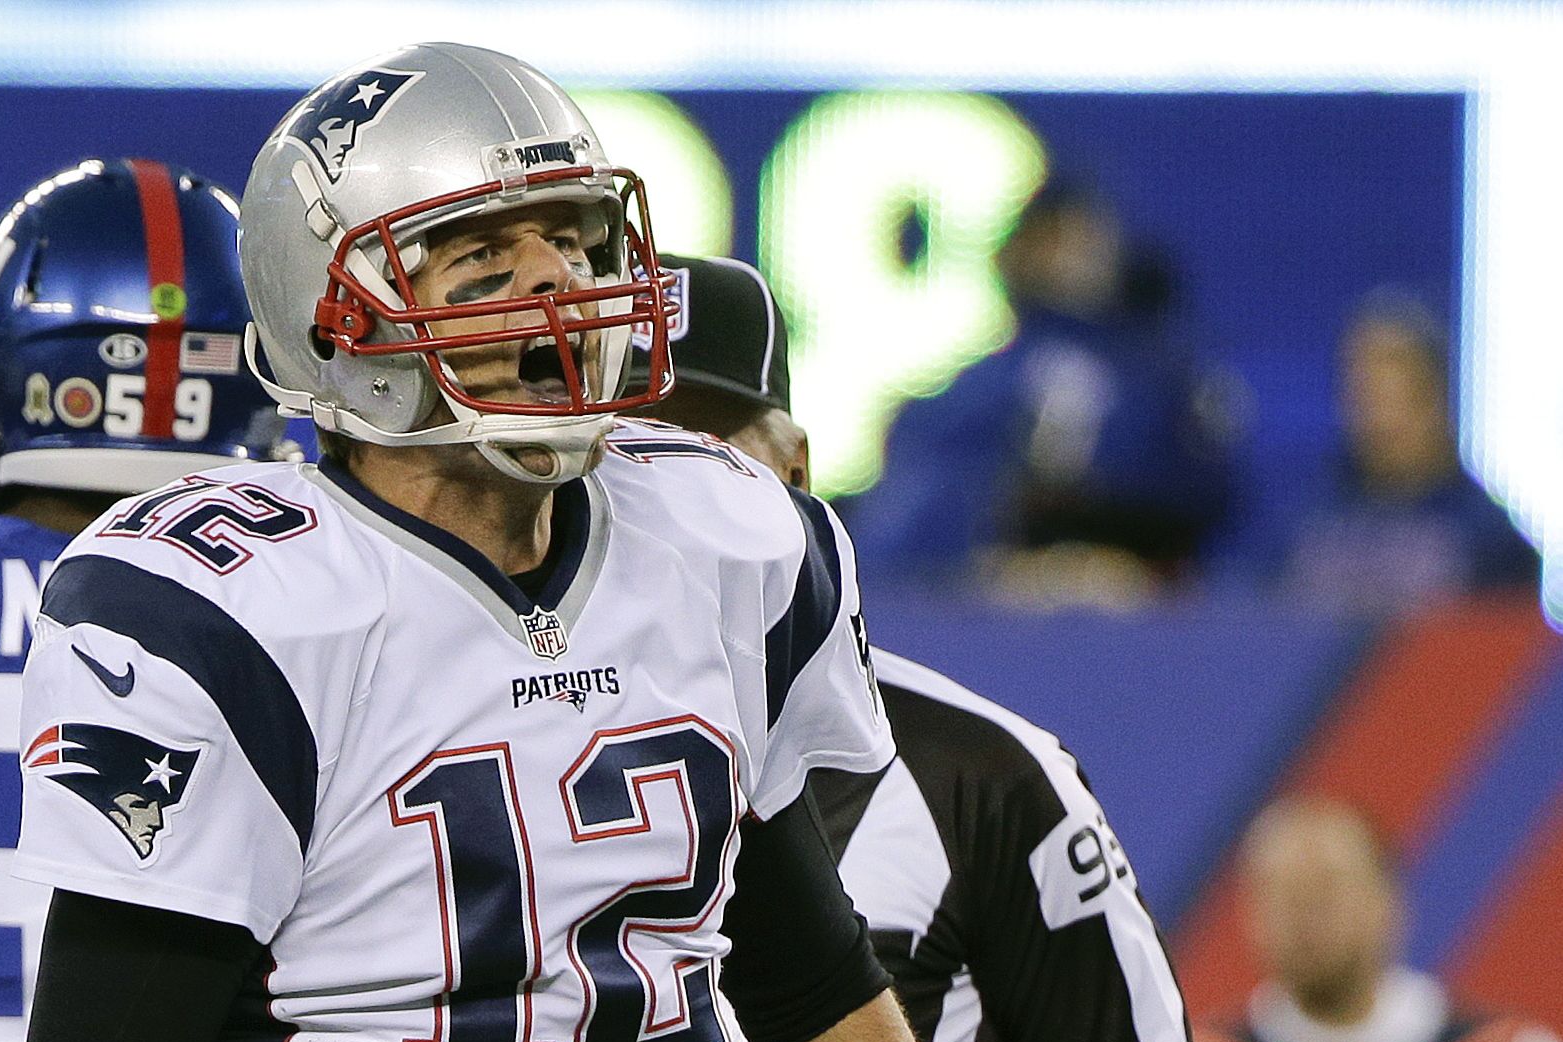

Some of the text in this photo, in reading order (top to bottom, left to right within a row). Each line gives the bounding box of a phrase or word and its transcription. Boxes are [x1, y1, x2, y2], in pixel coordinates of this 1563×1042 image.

[103, 373, 214, 442] 59
[95, 474, 319, 577] 12
[532, 630, 565, 655] NFL
[511, 666, 621, 708] PATRIOTS
